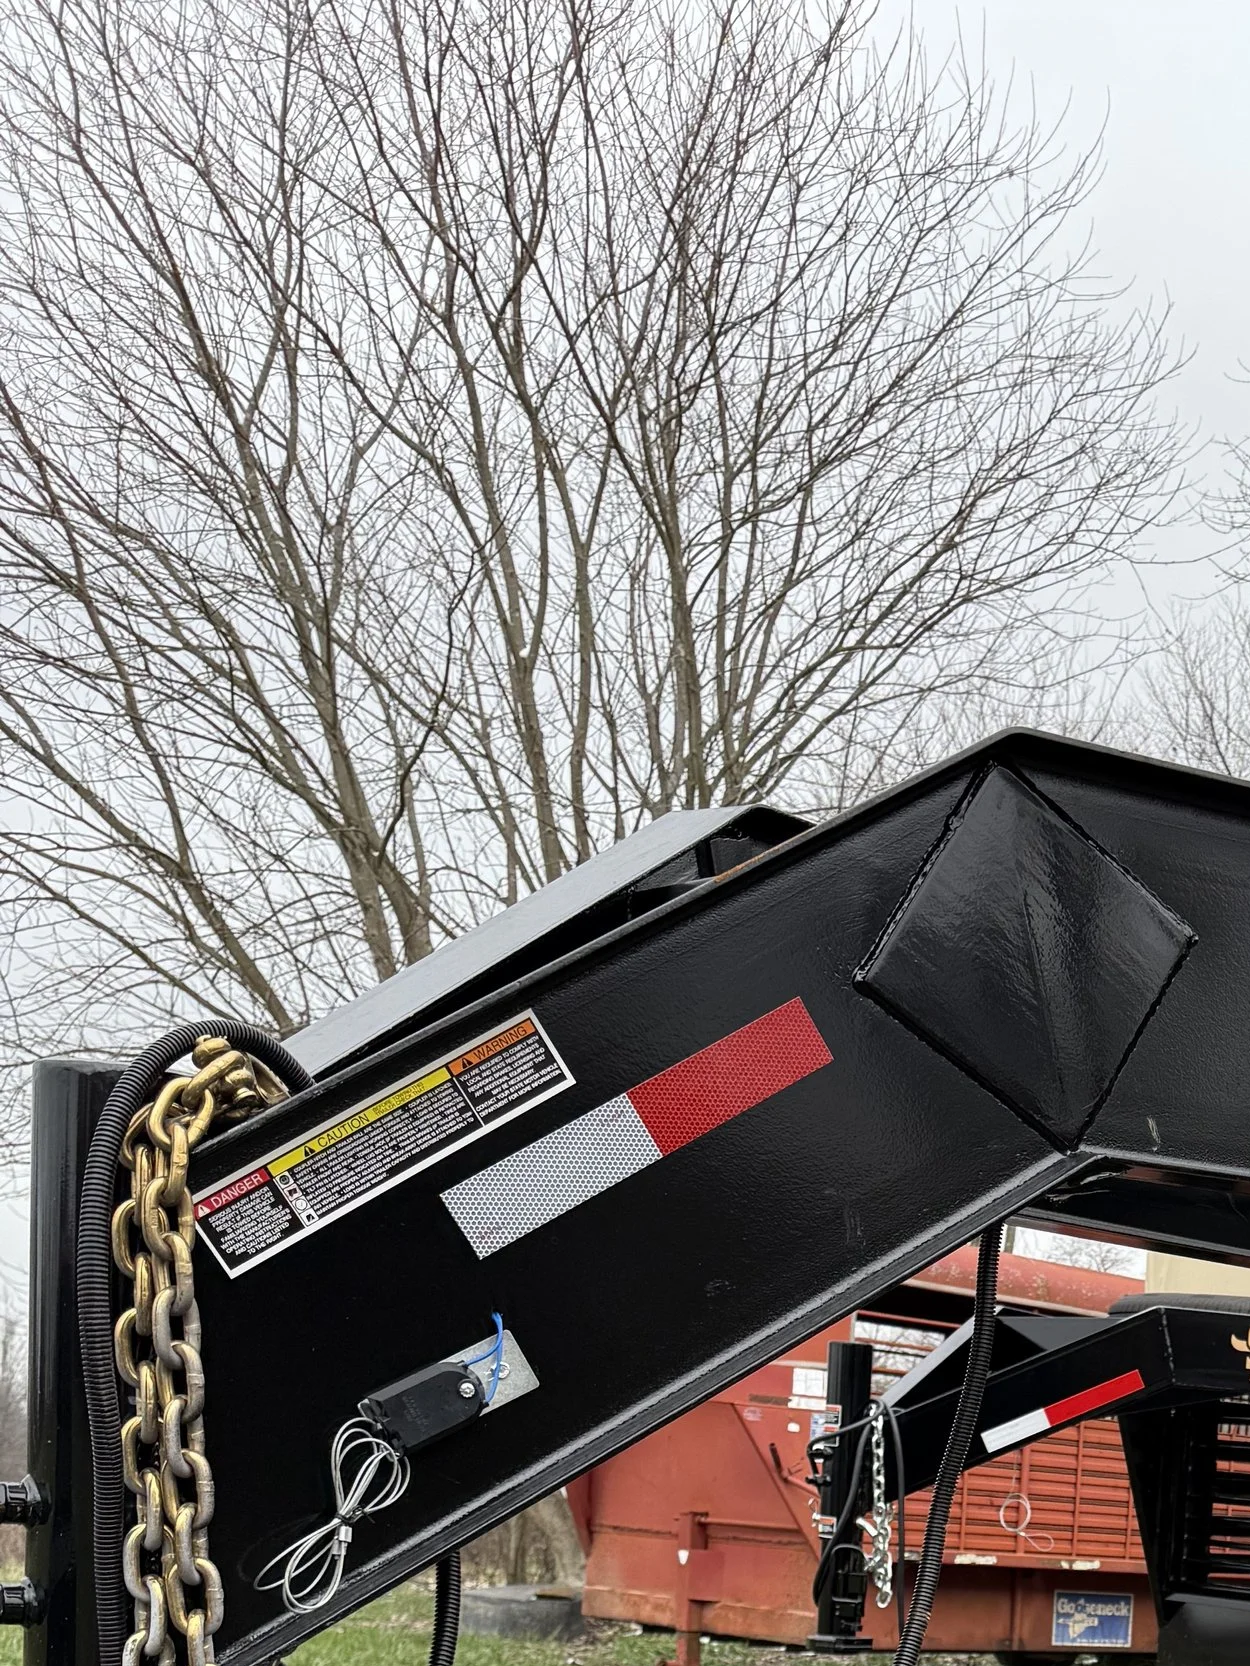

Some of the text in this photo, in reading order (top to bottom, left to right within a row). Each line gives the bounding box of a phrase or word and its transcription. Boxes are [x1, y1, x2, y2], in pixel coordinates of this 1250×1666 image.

[473, 1025, 527, 1061] WARNING
[316, 1113, 370, 1148] CAUTION
[210, 1172, 263, 1208] DANGER
